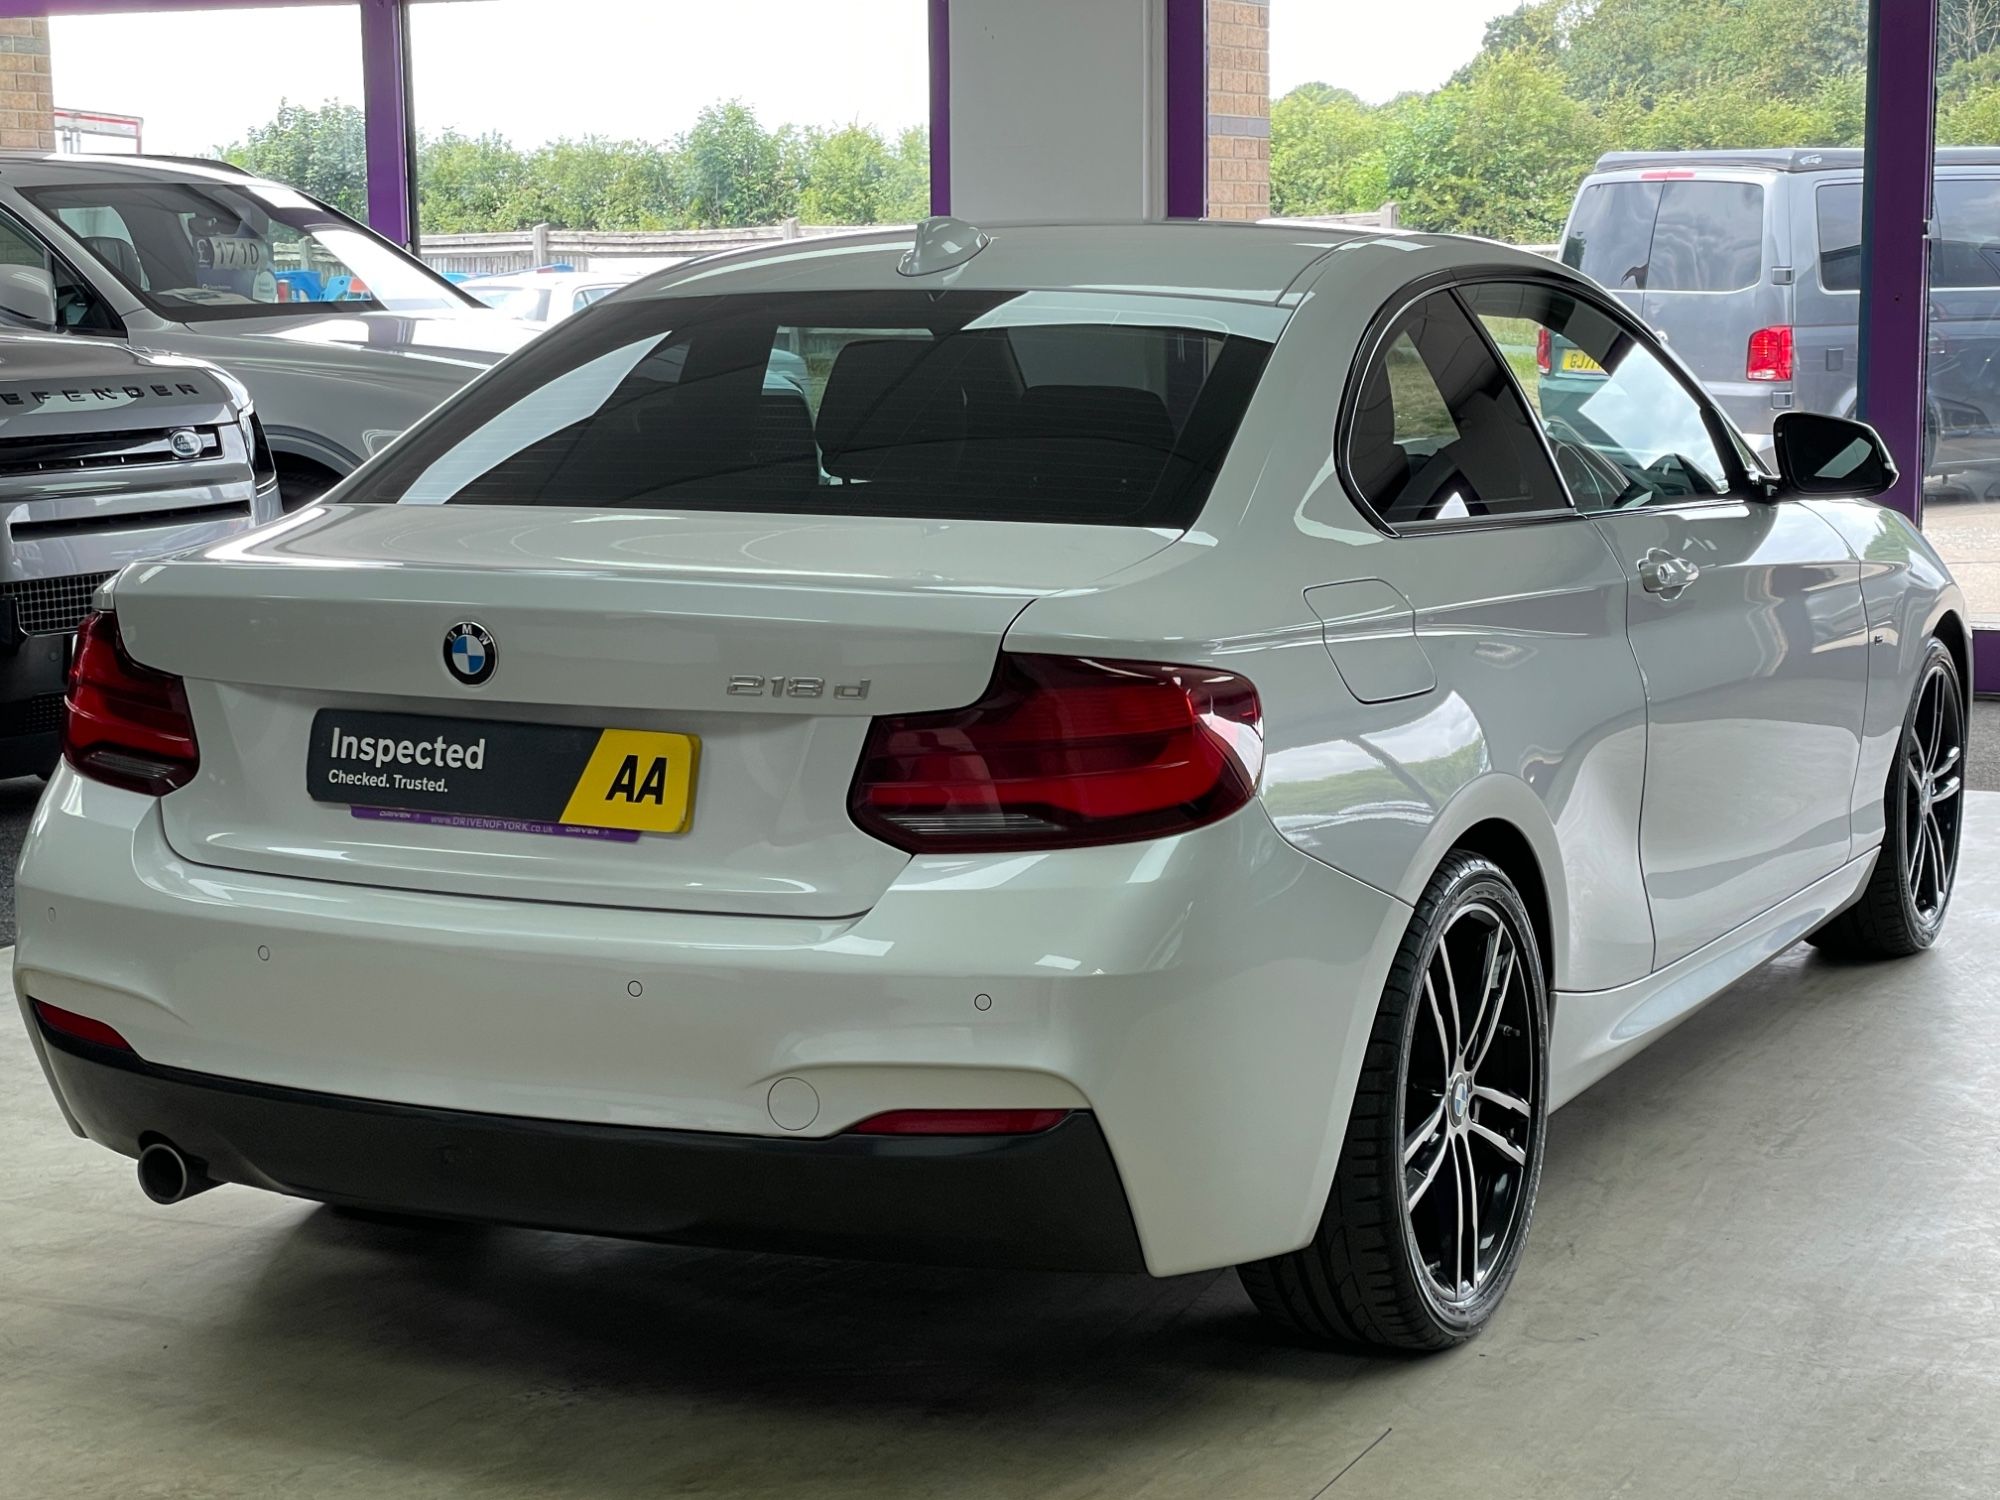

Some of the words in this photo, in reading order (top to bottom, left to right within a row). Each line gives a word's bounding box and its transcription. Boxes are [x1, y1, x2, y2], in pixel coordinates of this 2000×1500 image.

[0, 383, 200, 406] EFENDER
[446, 623, 491, 646] BMW
[331, 727, 486, 770] Inspected
[328, 769, 390, 788] Checked.
[393, 774, 448, 793] Trusted.
[605, 755, 667, 805] AA
